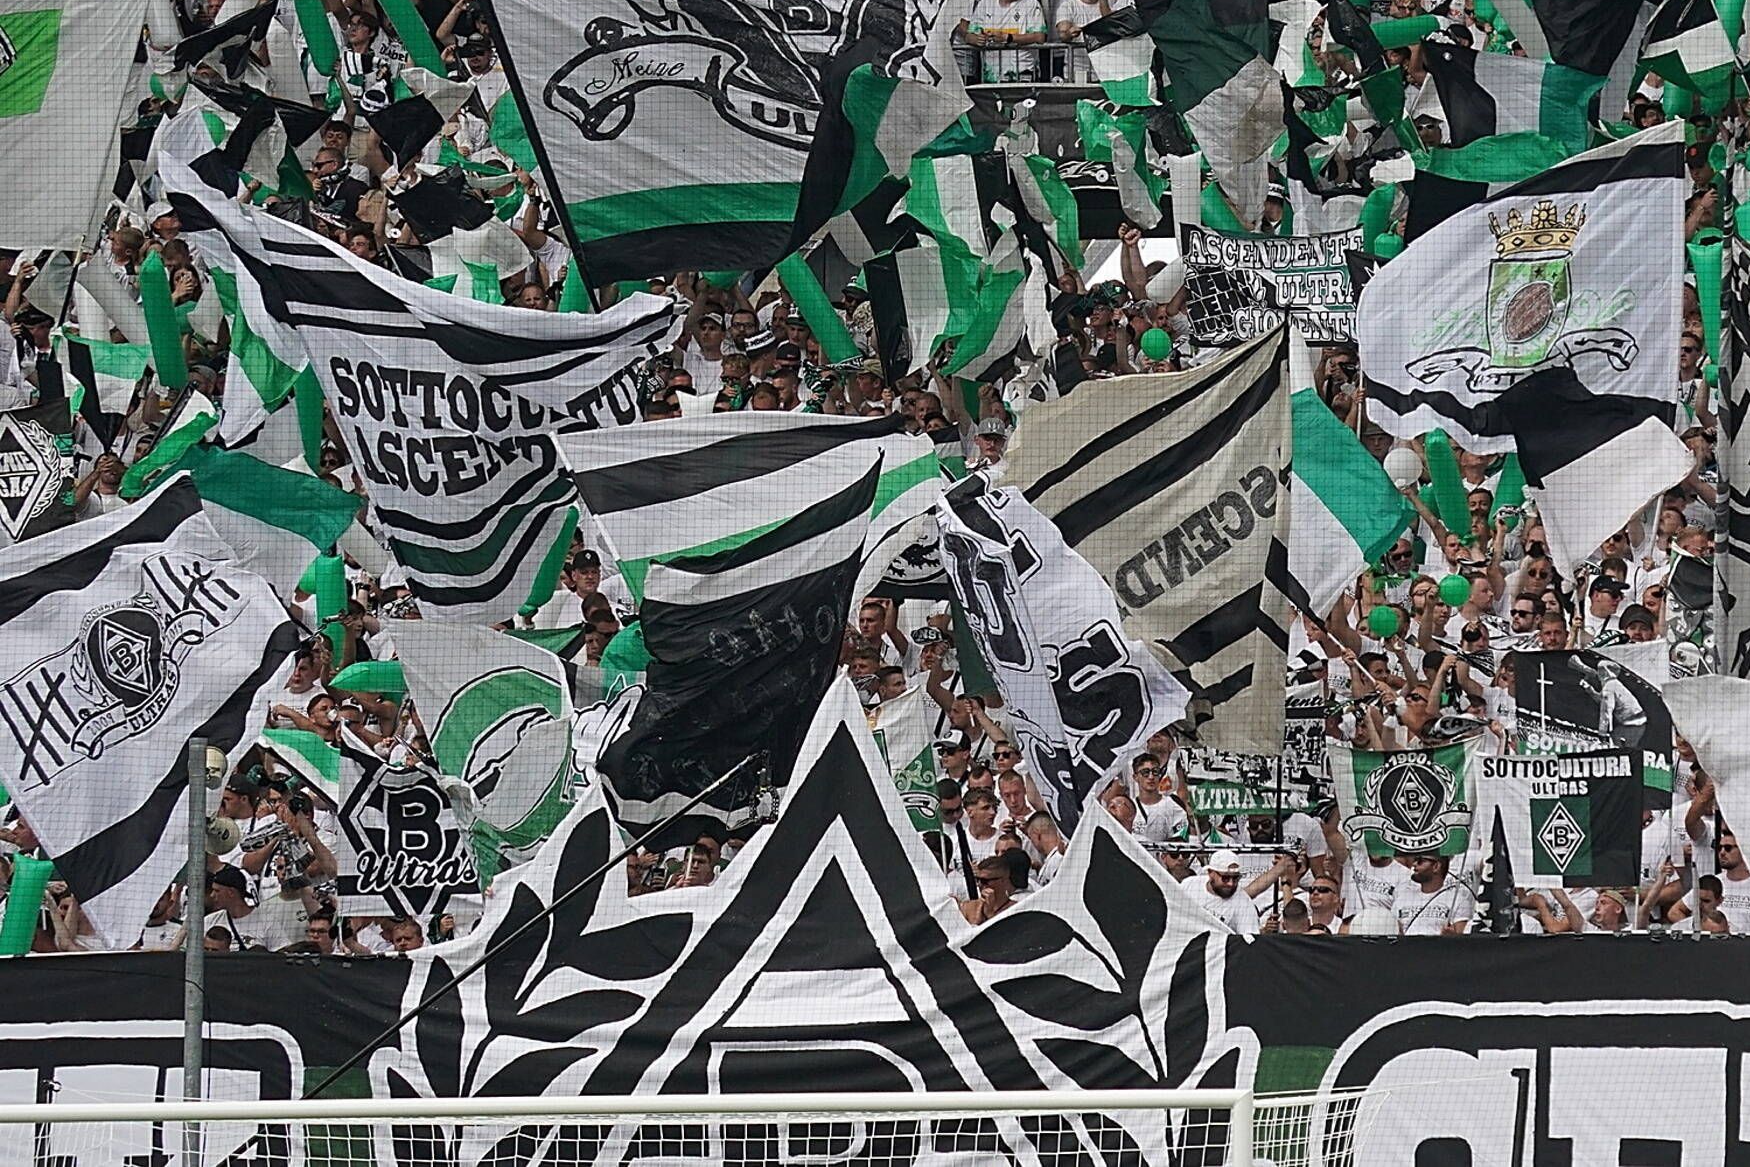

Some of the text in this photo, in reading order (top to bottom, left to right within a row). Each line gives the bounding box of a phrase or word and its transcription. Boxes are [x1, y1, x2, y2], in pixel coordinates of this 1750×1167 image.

[584, 50, 686, 96] Meine
[109, 640, 139, 677] B
[1388, 752, 1428, 766] 1900
[1482, 755, 1633, 779] SOTTOCULTURA
[1531, 780, 1589, 797] ULTRAS
[1404, 789, 1422, 813] B
[384, 783, 447, 860] B
[1553, 825, 1569, 848] B
[357, 849, 479, 894] Ultras
